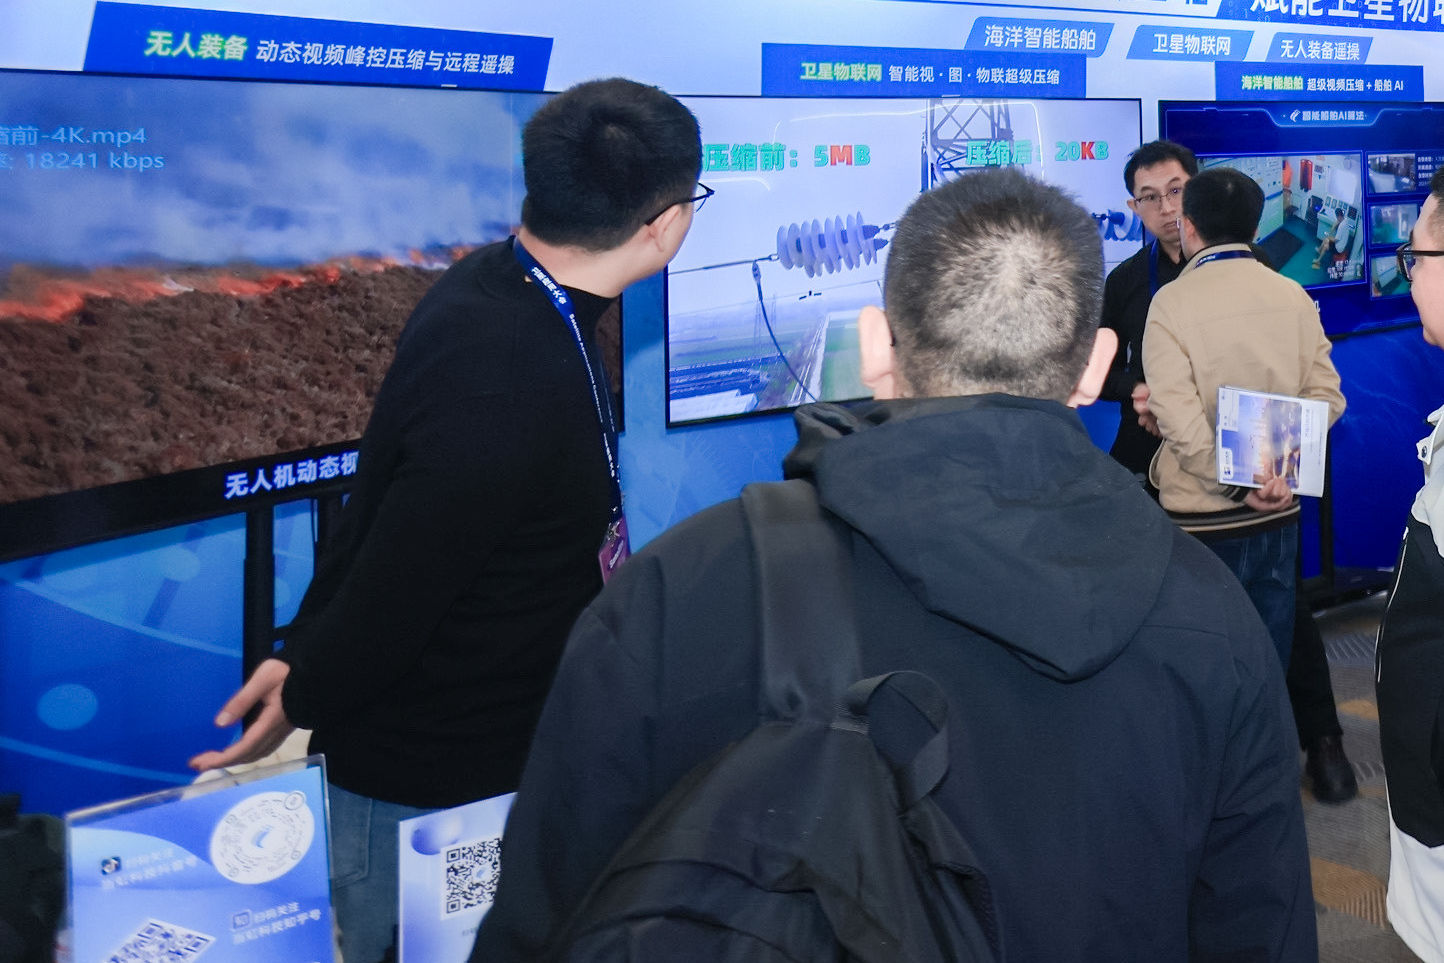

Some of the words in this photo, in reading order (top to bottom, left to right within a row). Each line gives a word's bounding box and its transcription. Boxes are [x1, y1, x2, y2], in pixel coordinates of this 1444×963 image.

[984, 24, 1096, 51] 海洋智能船舶
[1153, 34, 1231, 56] 卫星物联网
[145, 30, 248, 61] 无人装备
[256, 40, 515, 75] 动态视频峰控压缩与远程遥操
[1280, 40, 1360, 62] 无人装备遥操
[800, 62, 882, 82] 卫星物联网
[1241, 75, 1304, 91] 海洋智能船舶
[1306, 78, 1364, 92] 超级视频压缩
[1373, 79, 1392, 92] 船舶
[1394, 80, 1404, 91] AI
[26, 152, 98, 170] 18241
[110, 151, 165, 173] kbps
[813, 144, 872, 167] 5MB
[1054, 140, 1109, 162] 20KB
